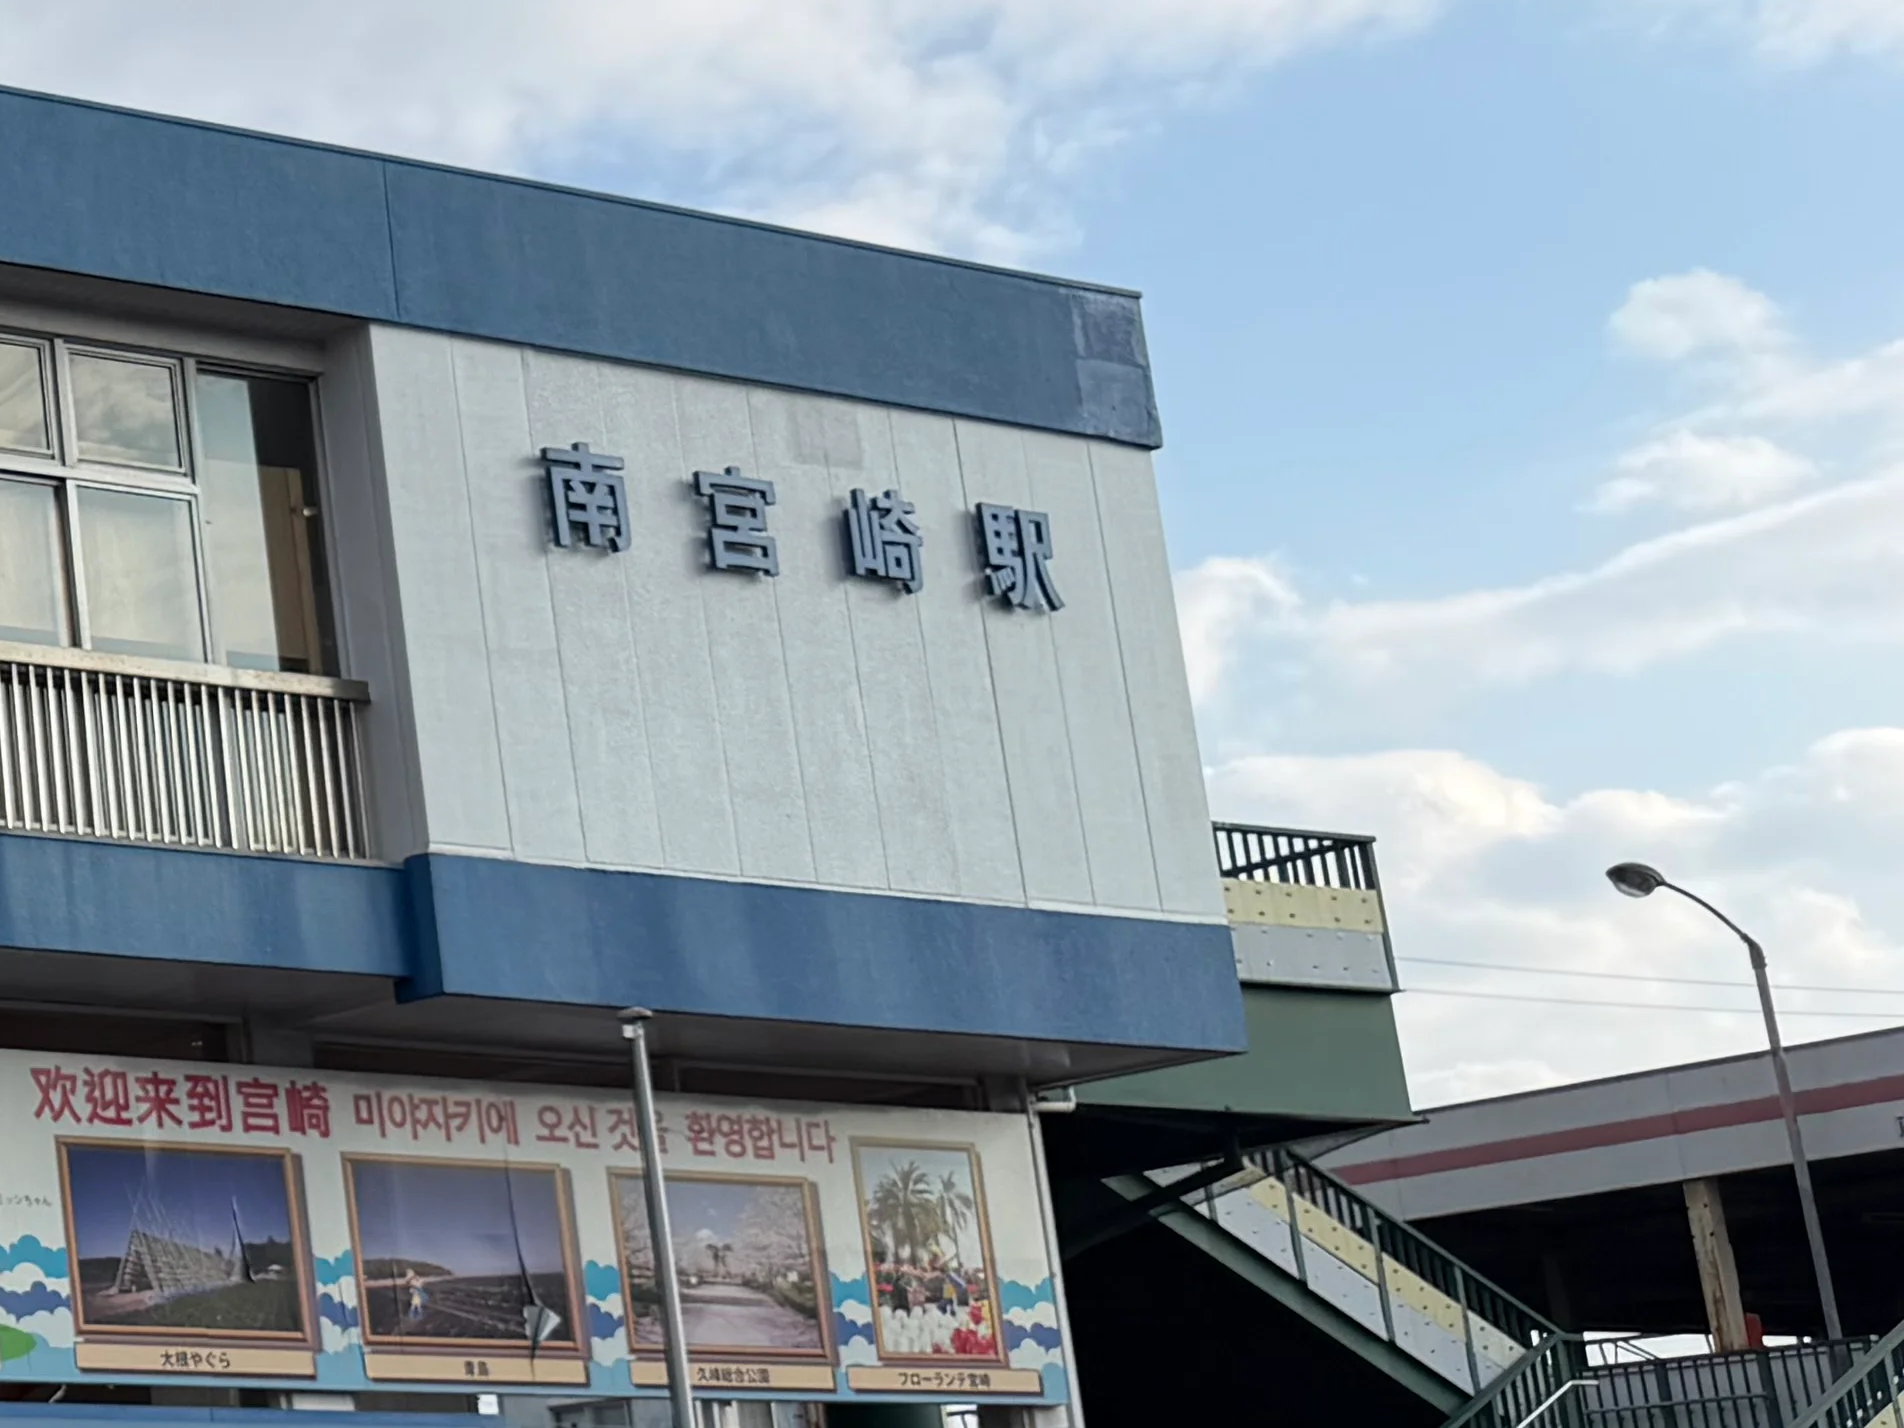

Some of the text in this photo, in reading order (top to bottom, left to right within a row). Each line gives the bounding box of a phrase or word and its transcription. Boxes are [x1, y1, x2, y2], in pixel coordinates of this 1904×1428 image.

[540, 442, 1065, 611] 南宮崎駅
[353, 1090, 520, 1146] 미야자키에
[536, 1105, 599, 1150] 오신
[685, 1110, 836, 1163] 환영합니다
